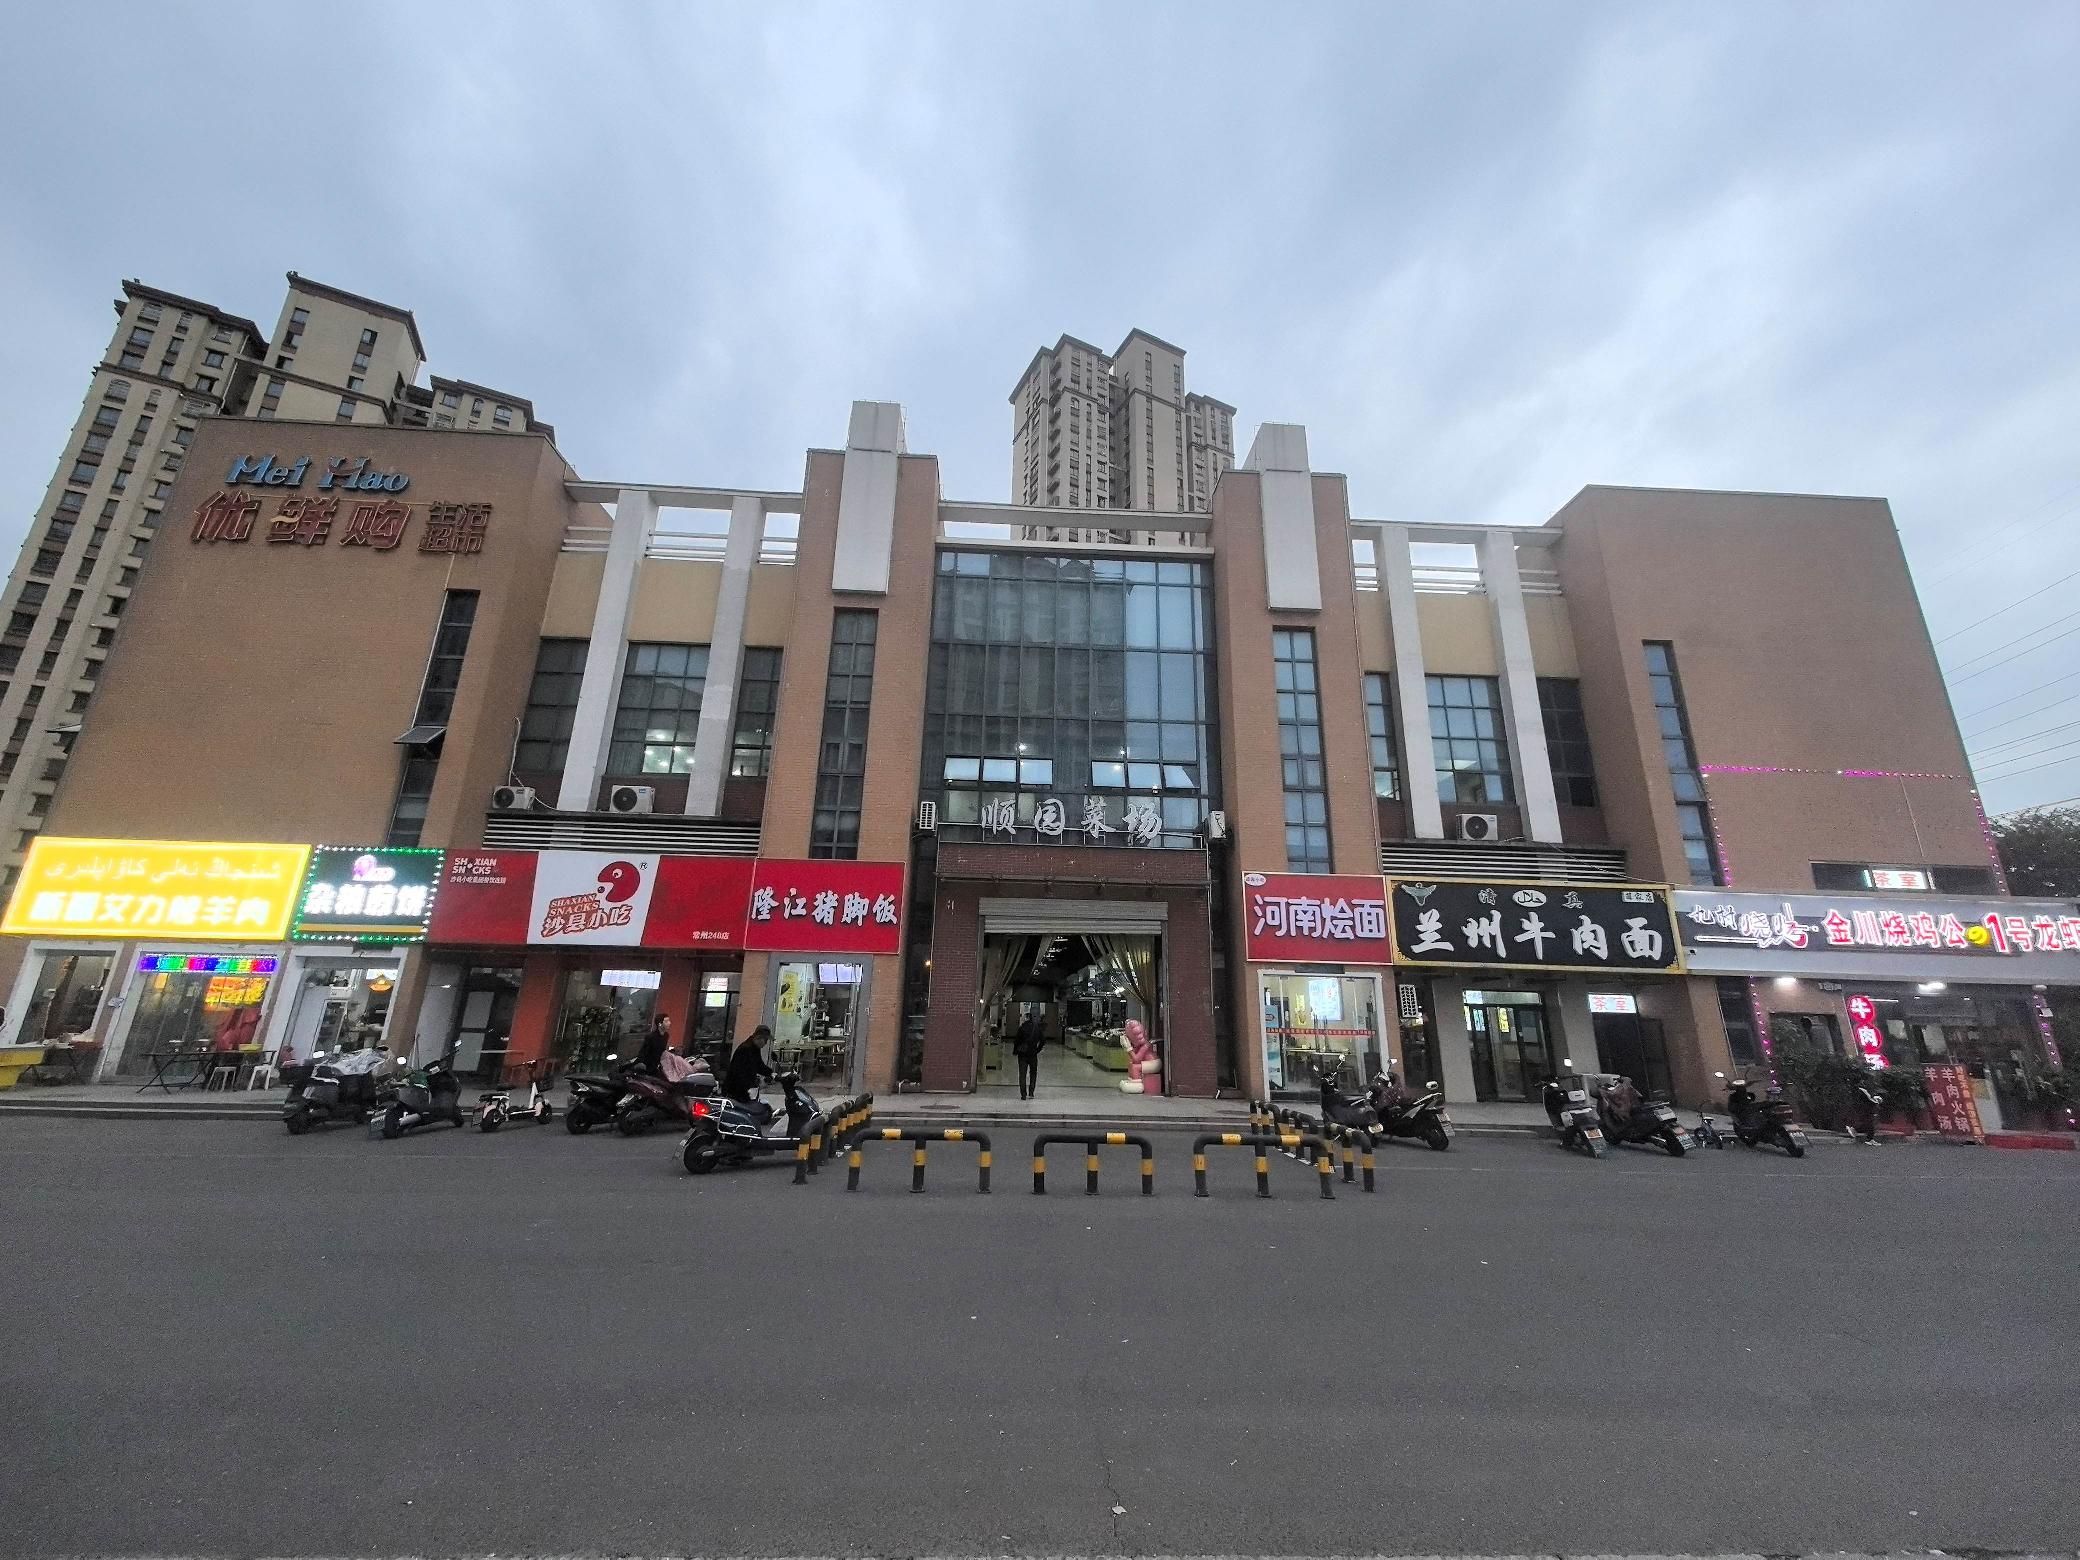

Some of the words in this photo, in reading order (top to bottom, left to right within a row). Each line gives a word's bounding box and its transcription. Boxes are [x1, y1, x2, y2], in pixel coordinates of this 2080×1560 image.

[225, 453, 312, 486] Mei
[318, 455, 409, 492] Hao
[191, 489, 411, 550] 优鲜购
[425, 501, 492, 528] 生活
[417, 526, 487, 552] 超市
[982, 796, 1162, 847] 顺园菜场
[1874, 871, 1921, 888] 茶室
[550, 901, 600, 917] SNACKS
[551, 893, 598, 907] SHAXIAN
[751, 886, 898, 926] 隆江猪脚饭
[1254, 894, 1386, 939] 河南烩面
[541, 904, 632, 937] 沙县小吃
[1410, 908, 1663, 960] 兰州牛肉面
[1822, 908, 1968, 949] 金川烧鸡公
[1593, 996, 1628, 1011] 茶室
[1924, 1066, 1953, 1130] 羊肉汤
[1941, 1066, 1971, 1132] 羊肉火锅
